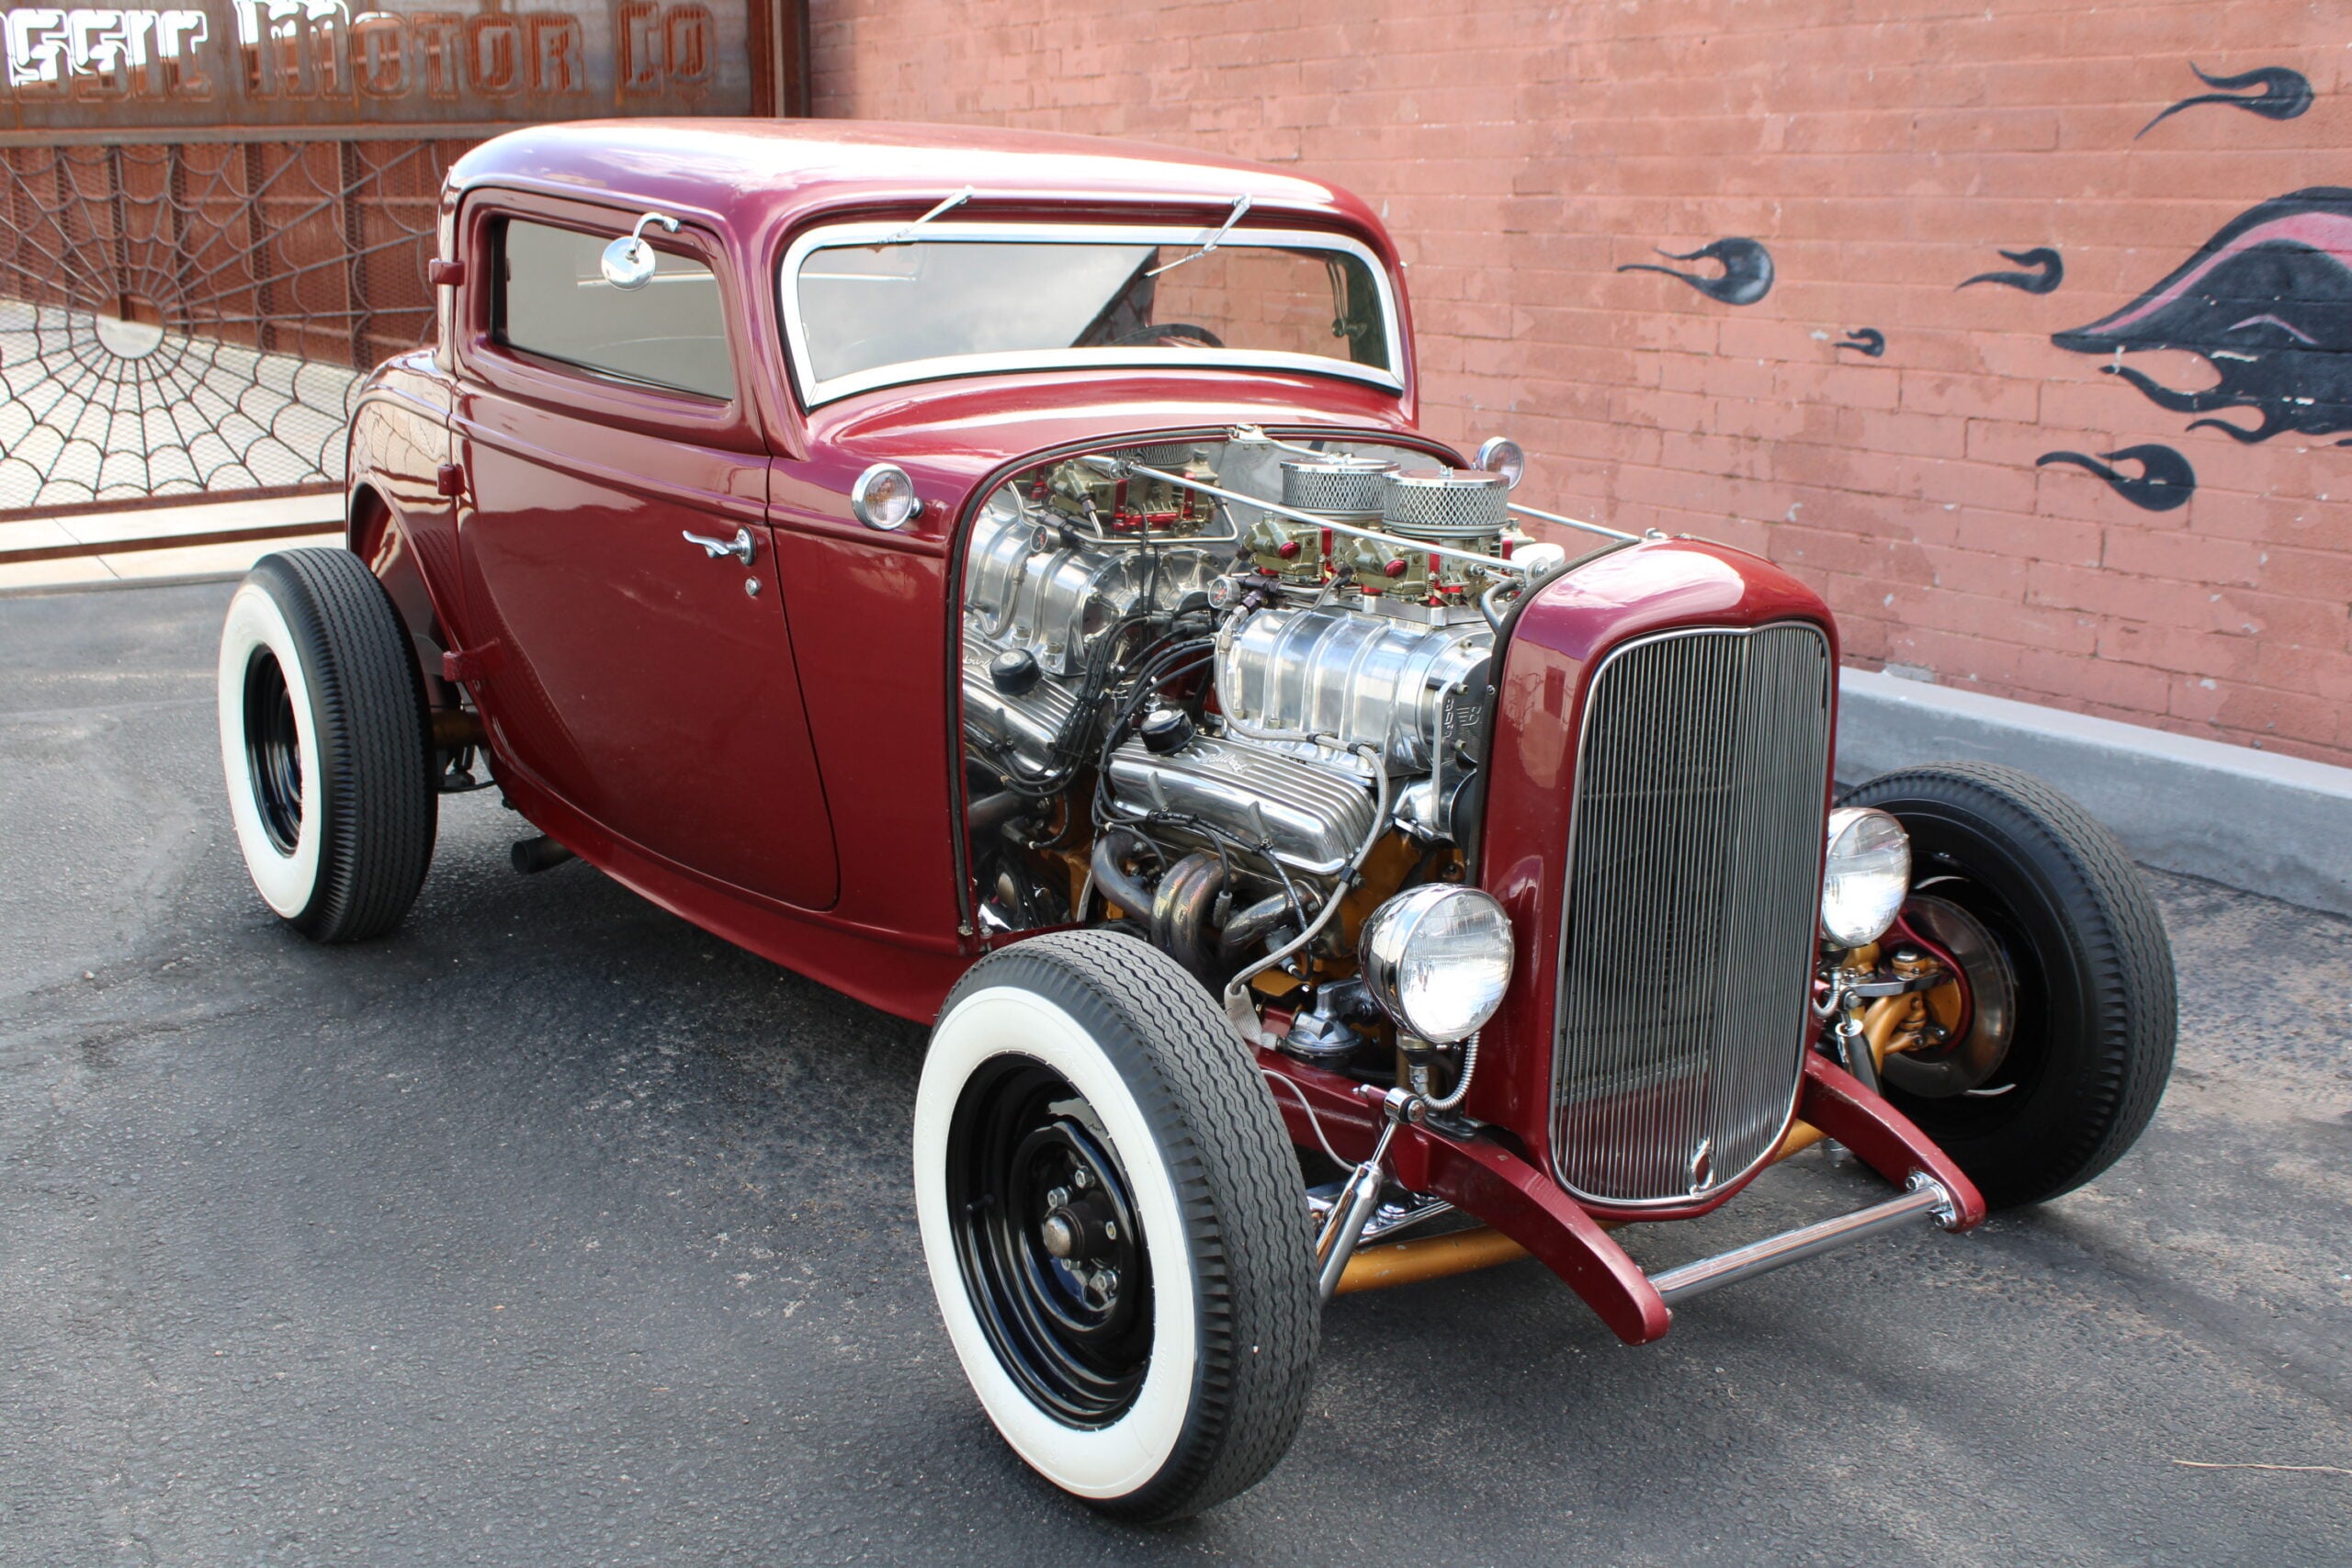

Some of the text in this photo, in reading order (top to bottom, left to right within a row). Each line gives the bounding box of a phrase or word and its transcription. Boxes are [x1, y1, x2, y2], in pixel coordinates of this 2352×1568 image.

[0, 0, 718, 103] SSIC MOTOR CO
